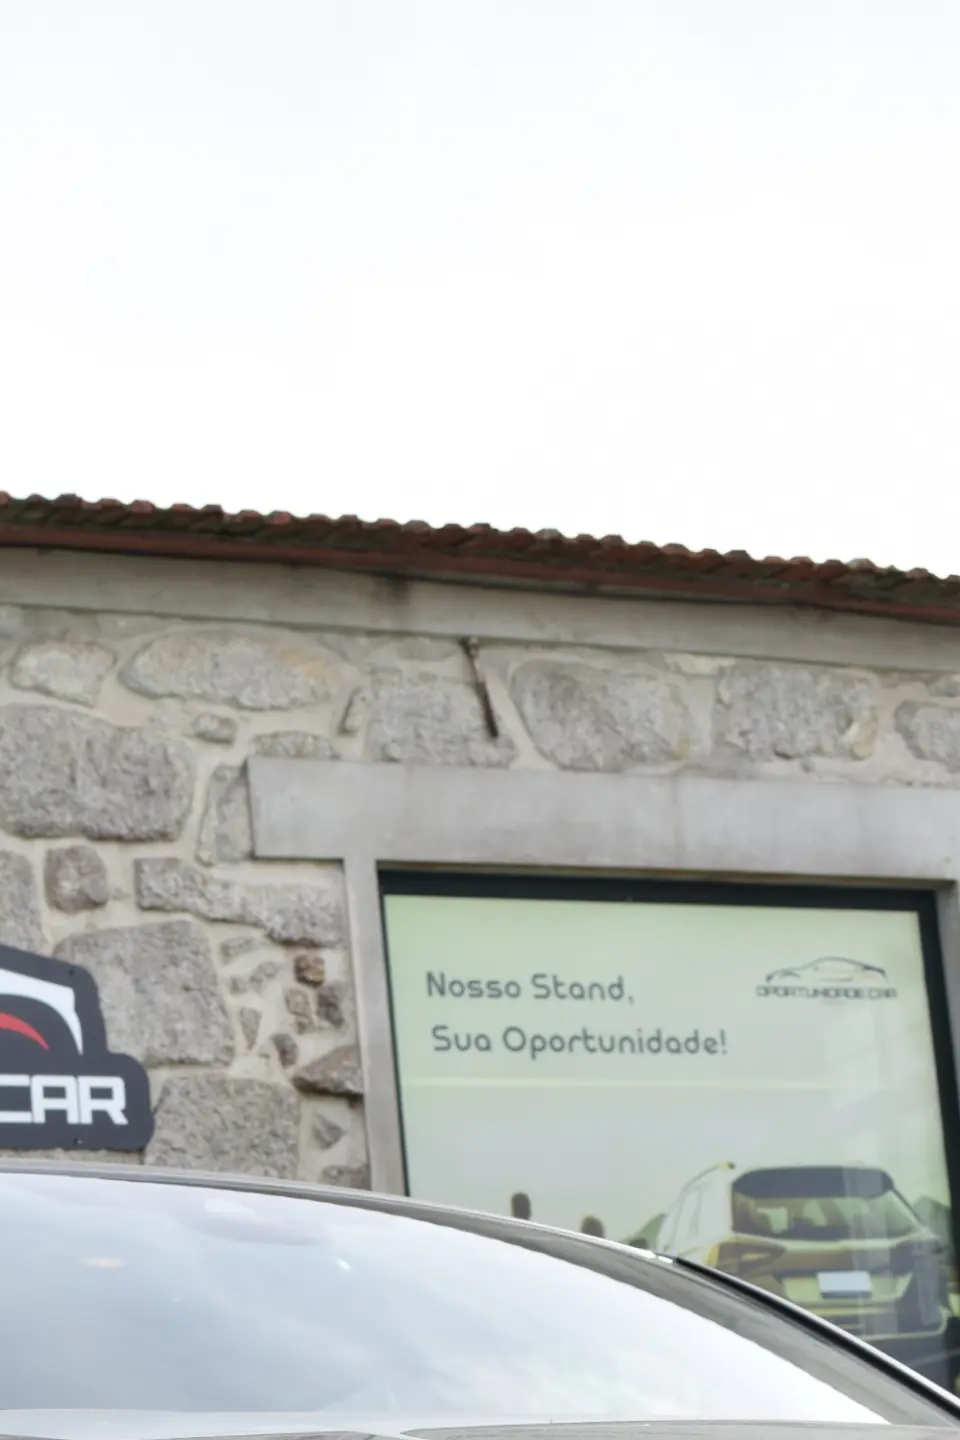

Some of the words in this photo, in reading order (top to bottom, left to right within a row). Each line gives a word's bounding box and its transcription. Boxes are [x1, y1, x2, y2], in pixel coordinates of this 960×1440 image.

[426, 971, 522, 999] Nosso
[531, 973, 636, 1005] Stand,
[431, 1025, 493, 1053] Sua
[502, 1026, 728, 1060] Oportunidade!
